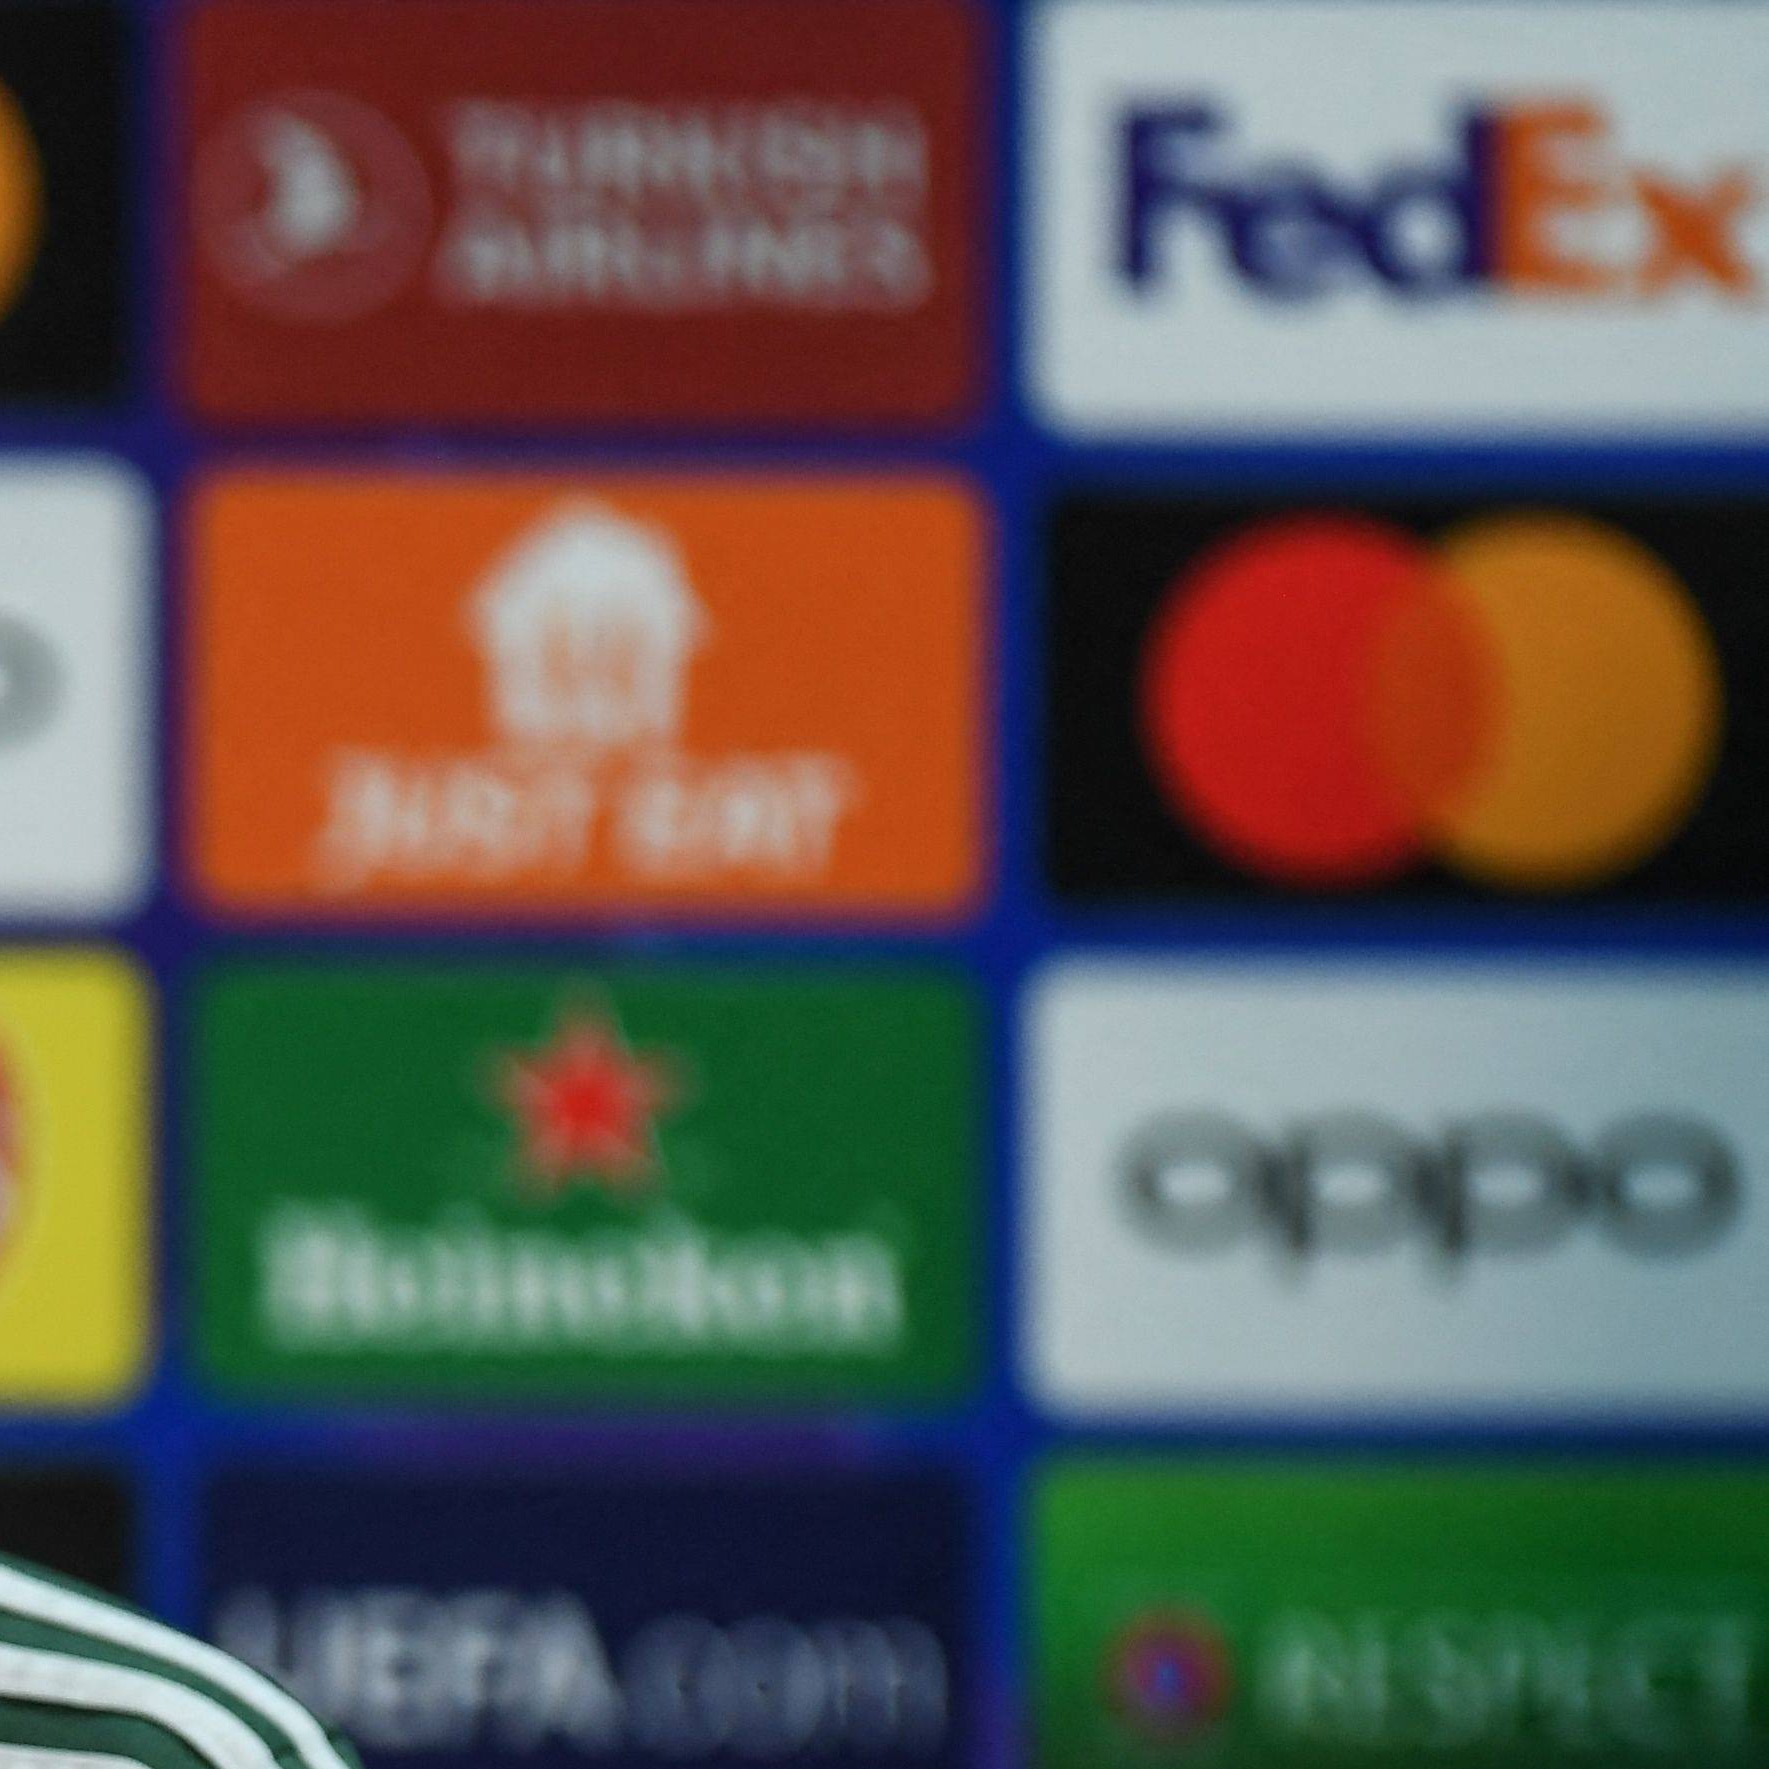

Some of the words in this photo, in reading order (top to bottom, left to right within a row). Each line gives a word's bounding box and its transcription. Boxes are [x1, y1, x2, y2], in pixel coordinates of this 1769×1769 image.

[447, 100, 927, 196] TURKISH
[1112, 95, 1766, 305] FedEx
[439, 214, 930, 312] AIRLINES
[314, 748, 597, 890] JUST
[612, 750, 855, 880] EAT
[1115, 1105, 1741, 1290] oppo
[259, 1205, 904, 1355] Heineken
[1270, 1608, 1752, 1750] RESPECT
